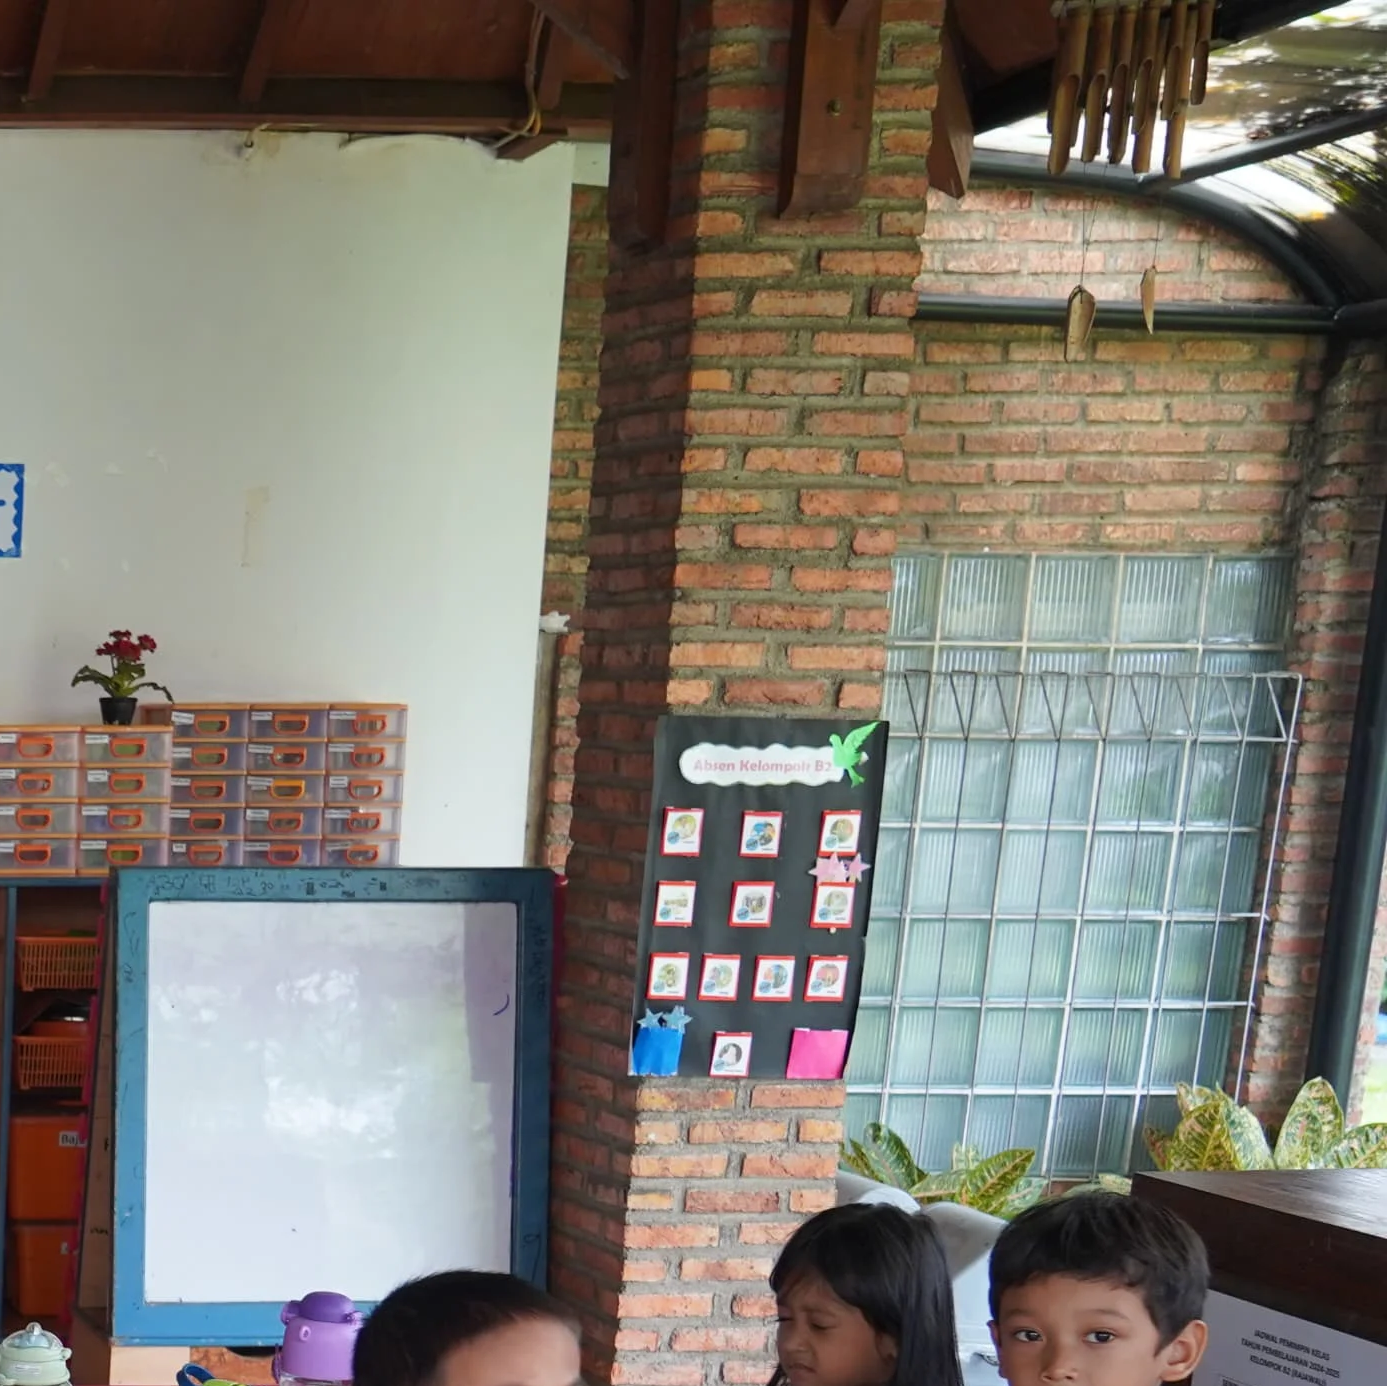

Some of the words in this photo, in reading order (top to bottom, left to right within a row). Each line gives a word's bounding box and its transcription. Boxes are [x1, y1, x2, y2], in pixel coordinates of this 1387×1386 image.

[693, 759, 735, 772] Absen
[1241, 1338, 1261, 1351] TAHUN
[1311, 1347, 1330, 1361] KELAS
[1250, 1355, 1282, 1373] KELOMPOK
